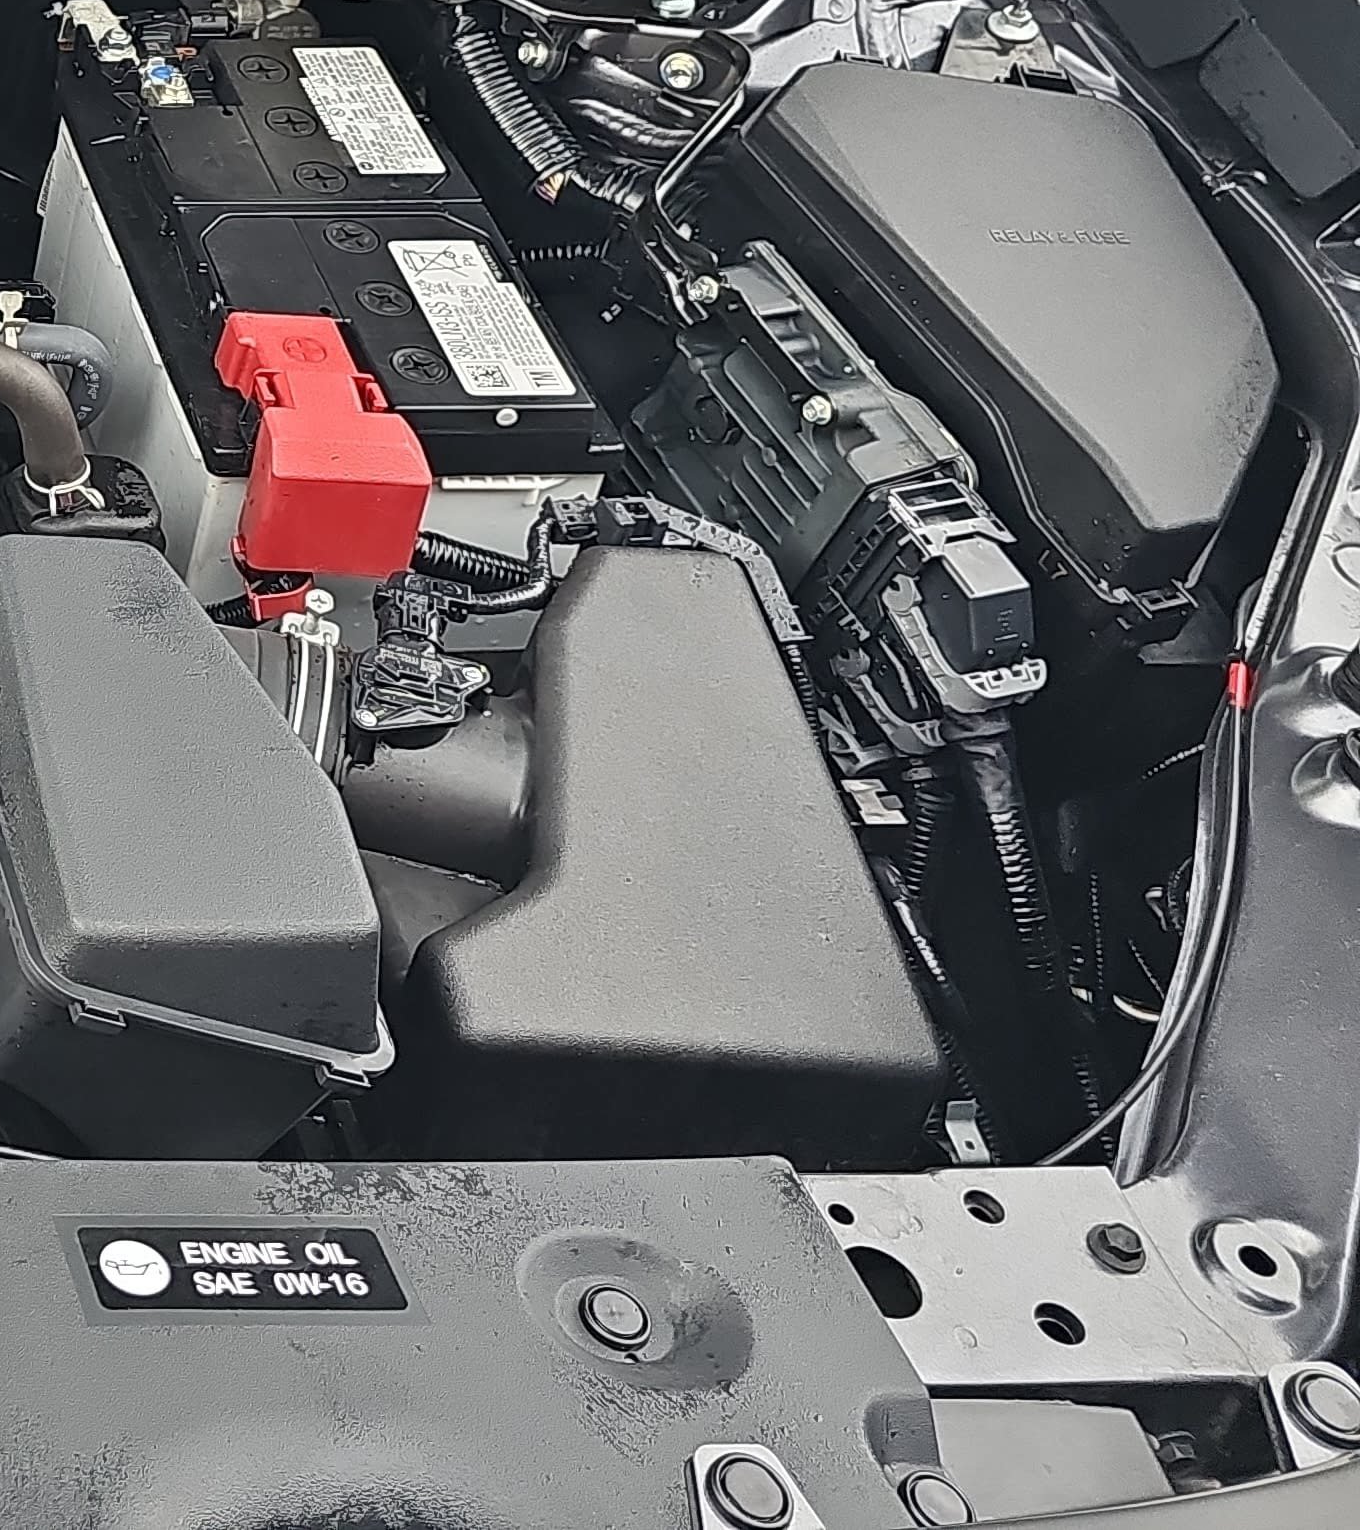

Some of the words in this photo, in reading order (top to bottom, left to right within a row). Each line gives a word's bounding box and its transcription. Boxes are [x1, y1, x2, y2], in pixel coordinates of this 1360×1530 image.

[989, 228, 1054, 244] RELAY
[1074, 228, 1131, 245] FUSE
[180, 1240, 289, 1267] ENGINE
[305, 1242, 360, 1267] OIL
[193, 1271, 260, 1296] SAE
[274, 1271, 371, 1297] 0W-16
